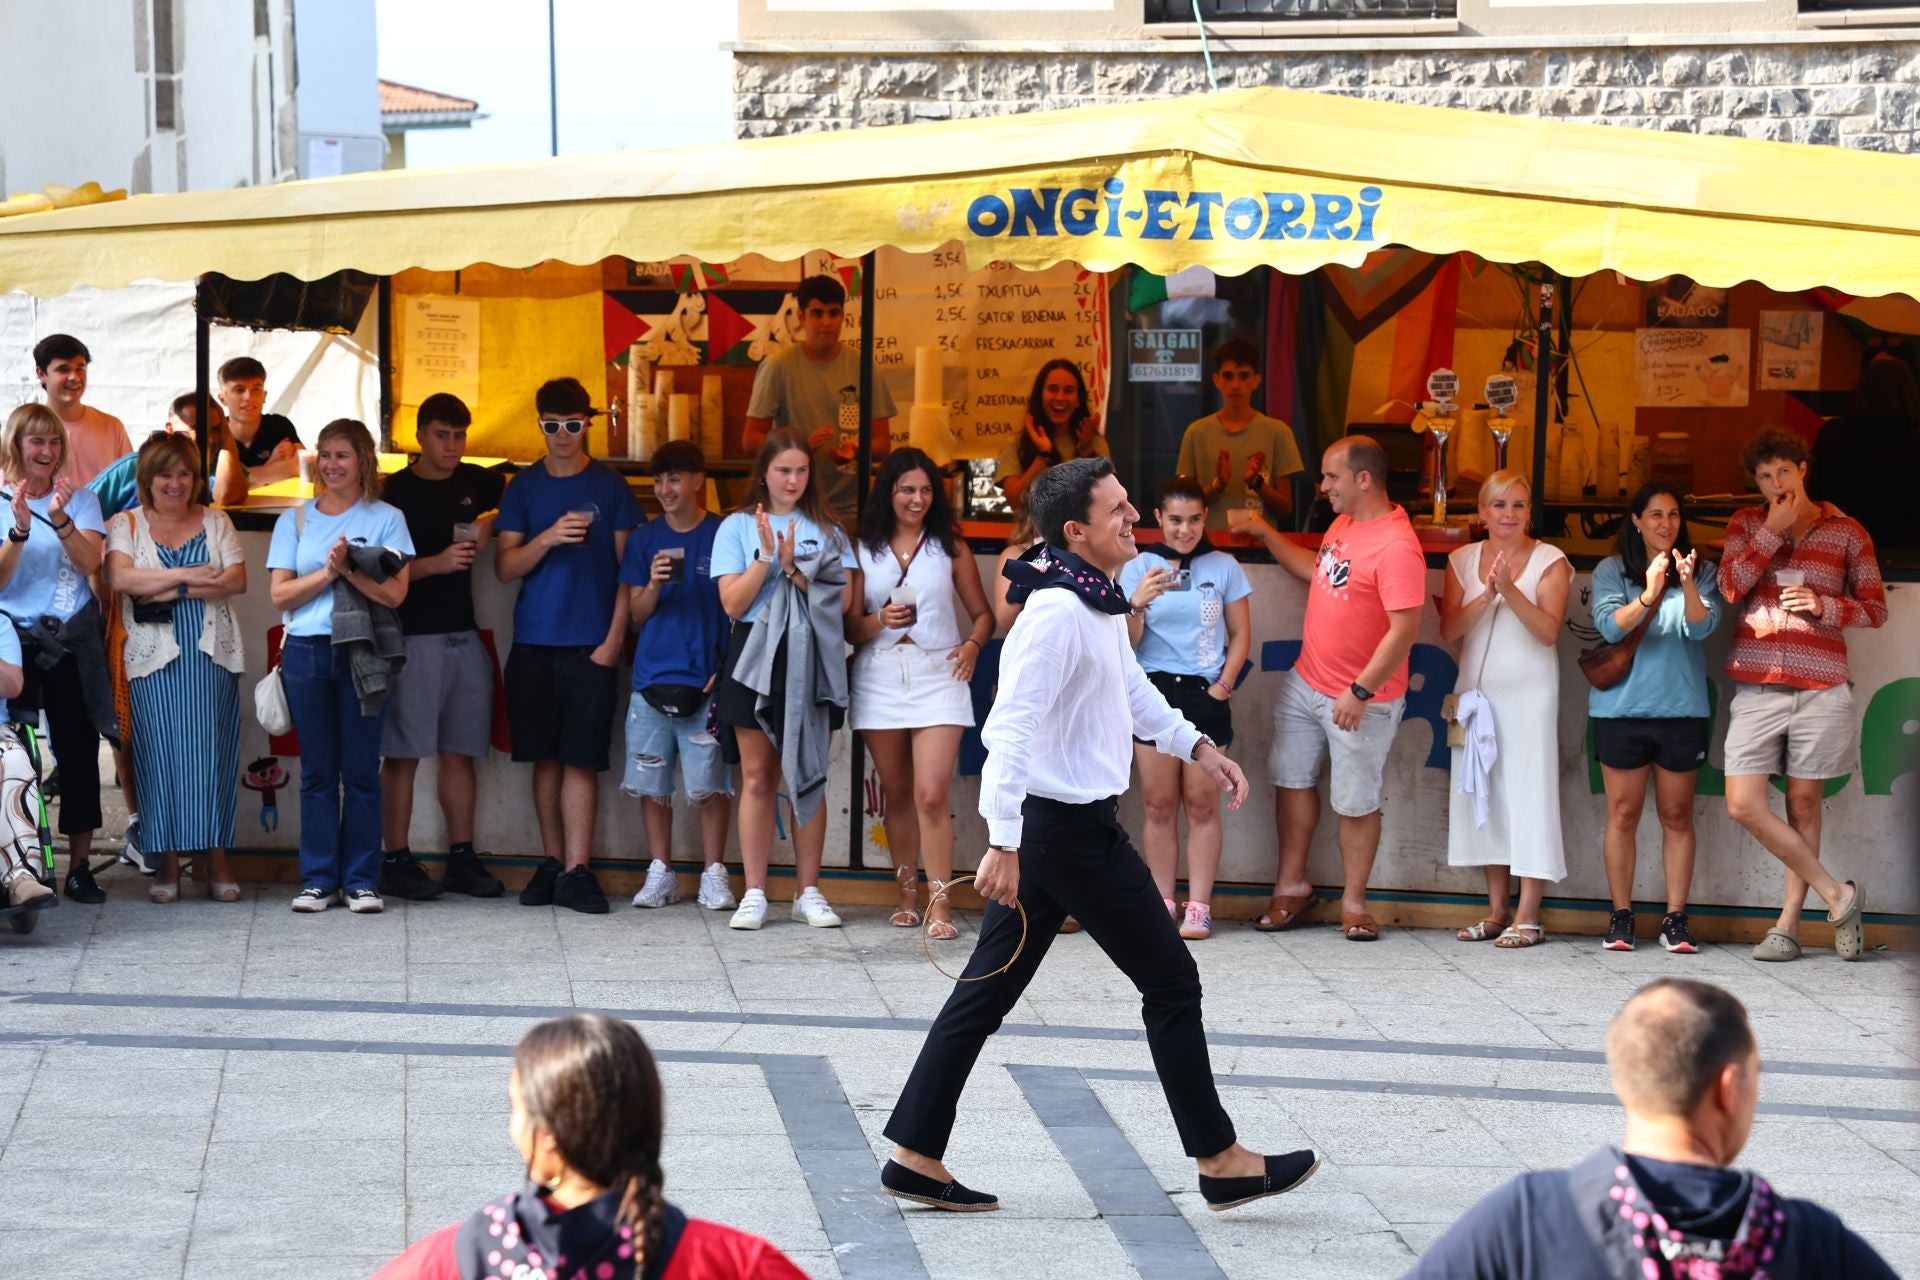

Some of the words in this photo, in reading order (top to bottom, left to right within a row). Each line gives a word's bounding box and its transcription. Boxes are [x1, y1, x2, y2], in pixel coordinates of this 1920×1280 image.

[935, 283, 964, 299] 1,5€
[977, 284, 1041, 298] TXUPITUA
[936, 307, 966, 323] 2,5€
[977, 311, 1015, 325] SATOR
[1657, 306, 1720, 318] BADAGO
[1134, 331, 1197, 349] SALGAI
[976, 368, 999, 380] URA
[1134, 365, 1194, 377] 617631819
[976, 394, 1030, 407] AZEITUNA
